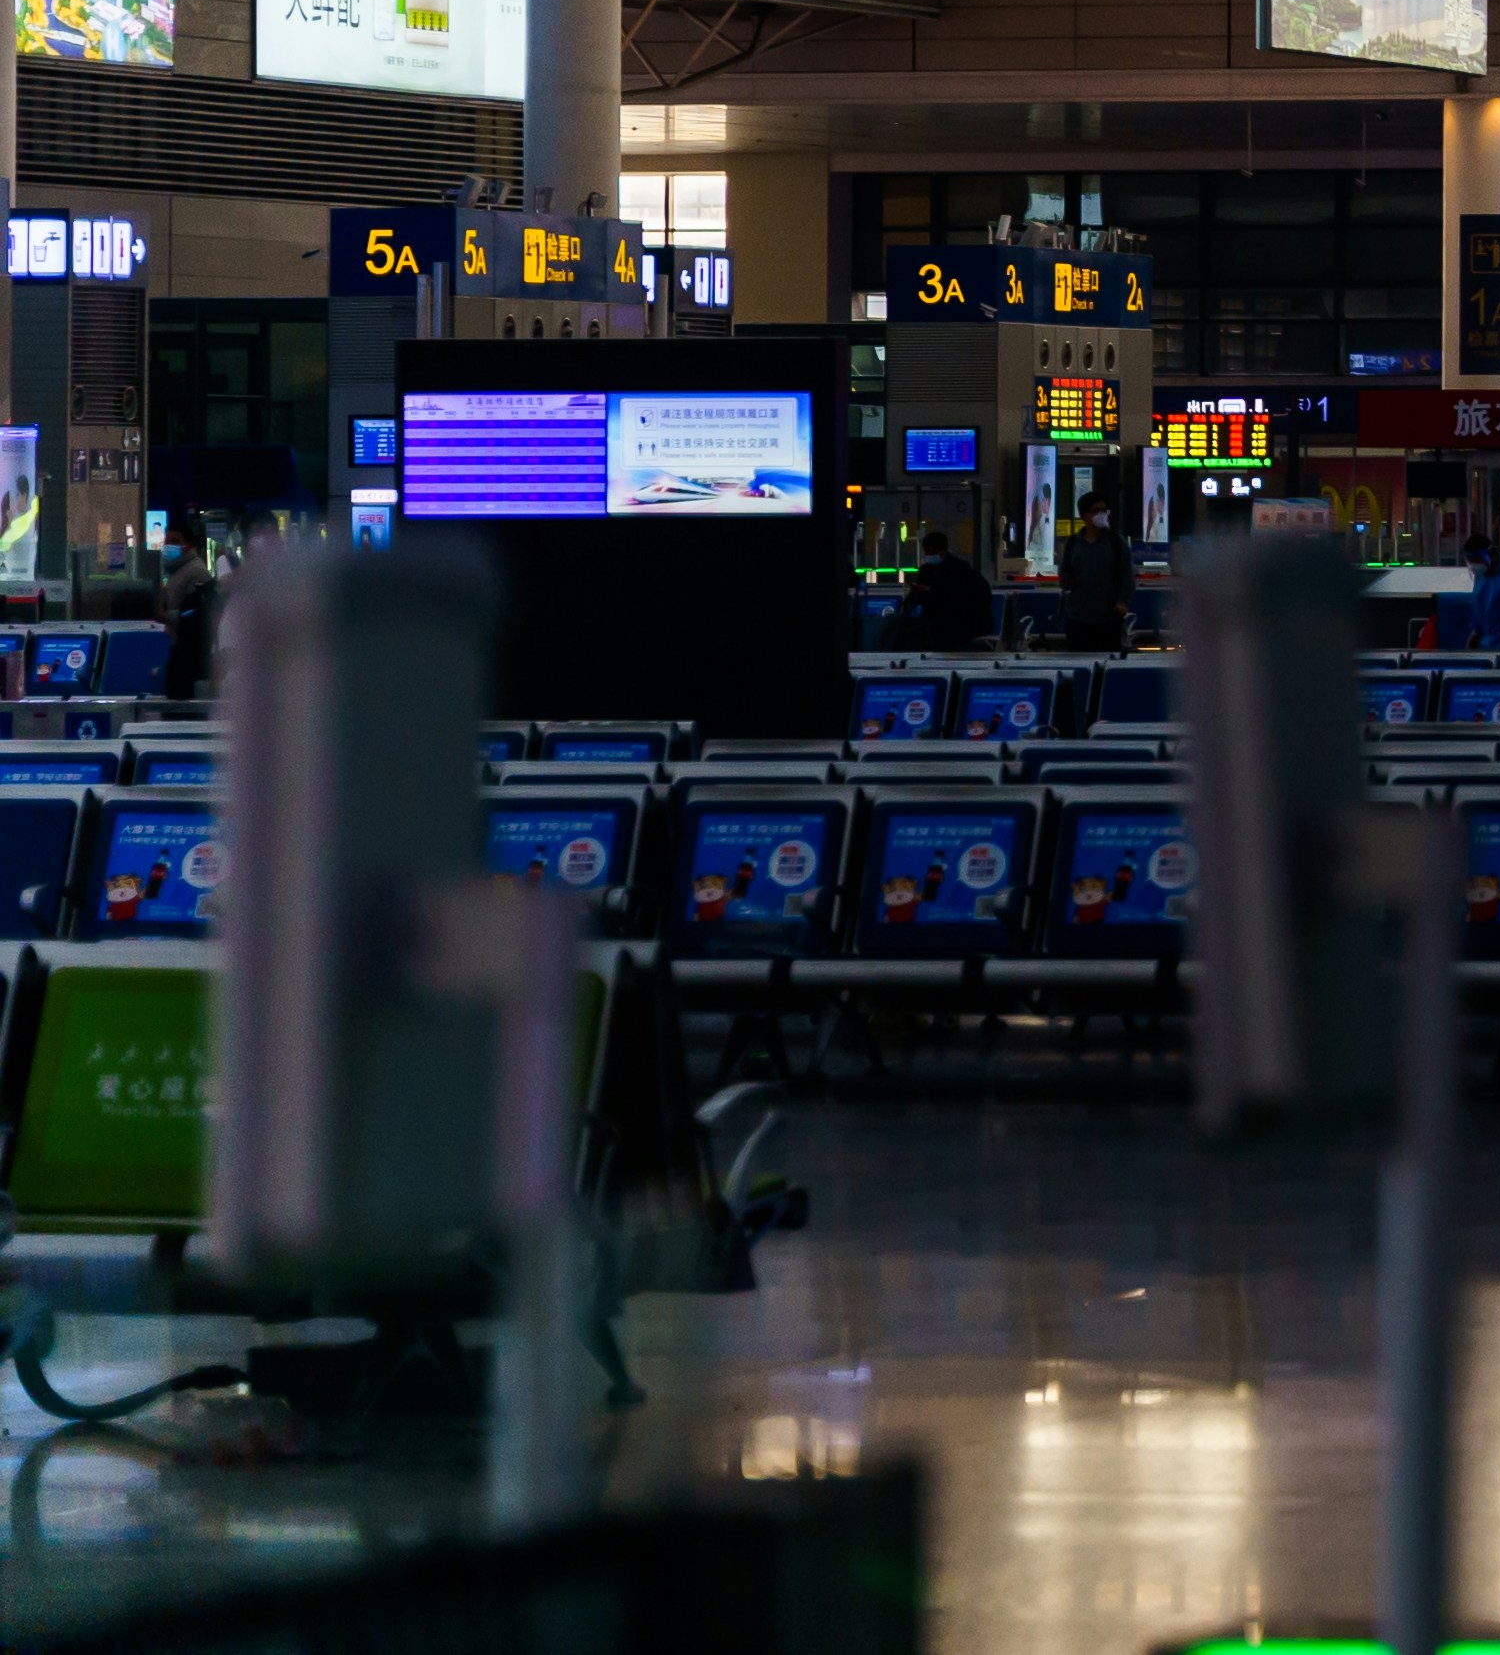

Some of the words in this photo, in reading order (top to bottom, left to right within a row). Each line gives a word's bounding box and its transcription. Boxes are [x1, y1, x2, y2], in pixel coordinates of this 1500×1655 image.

[365, 229, 419, 275] 5A
[463, 230, 487, 275] 5A
[546, 233, 581, 263] 检票口
[614, 238, 636, 284] 4A
[918, 263, 965, 304] 3A
[1006, 264, 1025, 305] 3A
[1072, 267, 1100, 293] 检票口
[1126, 271, 1144, 312] 2A
